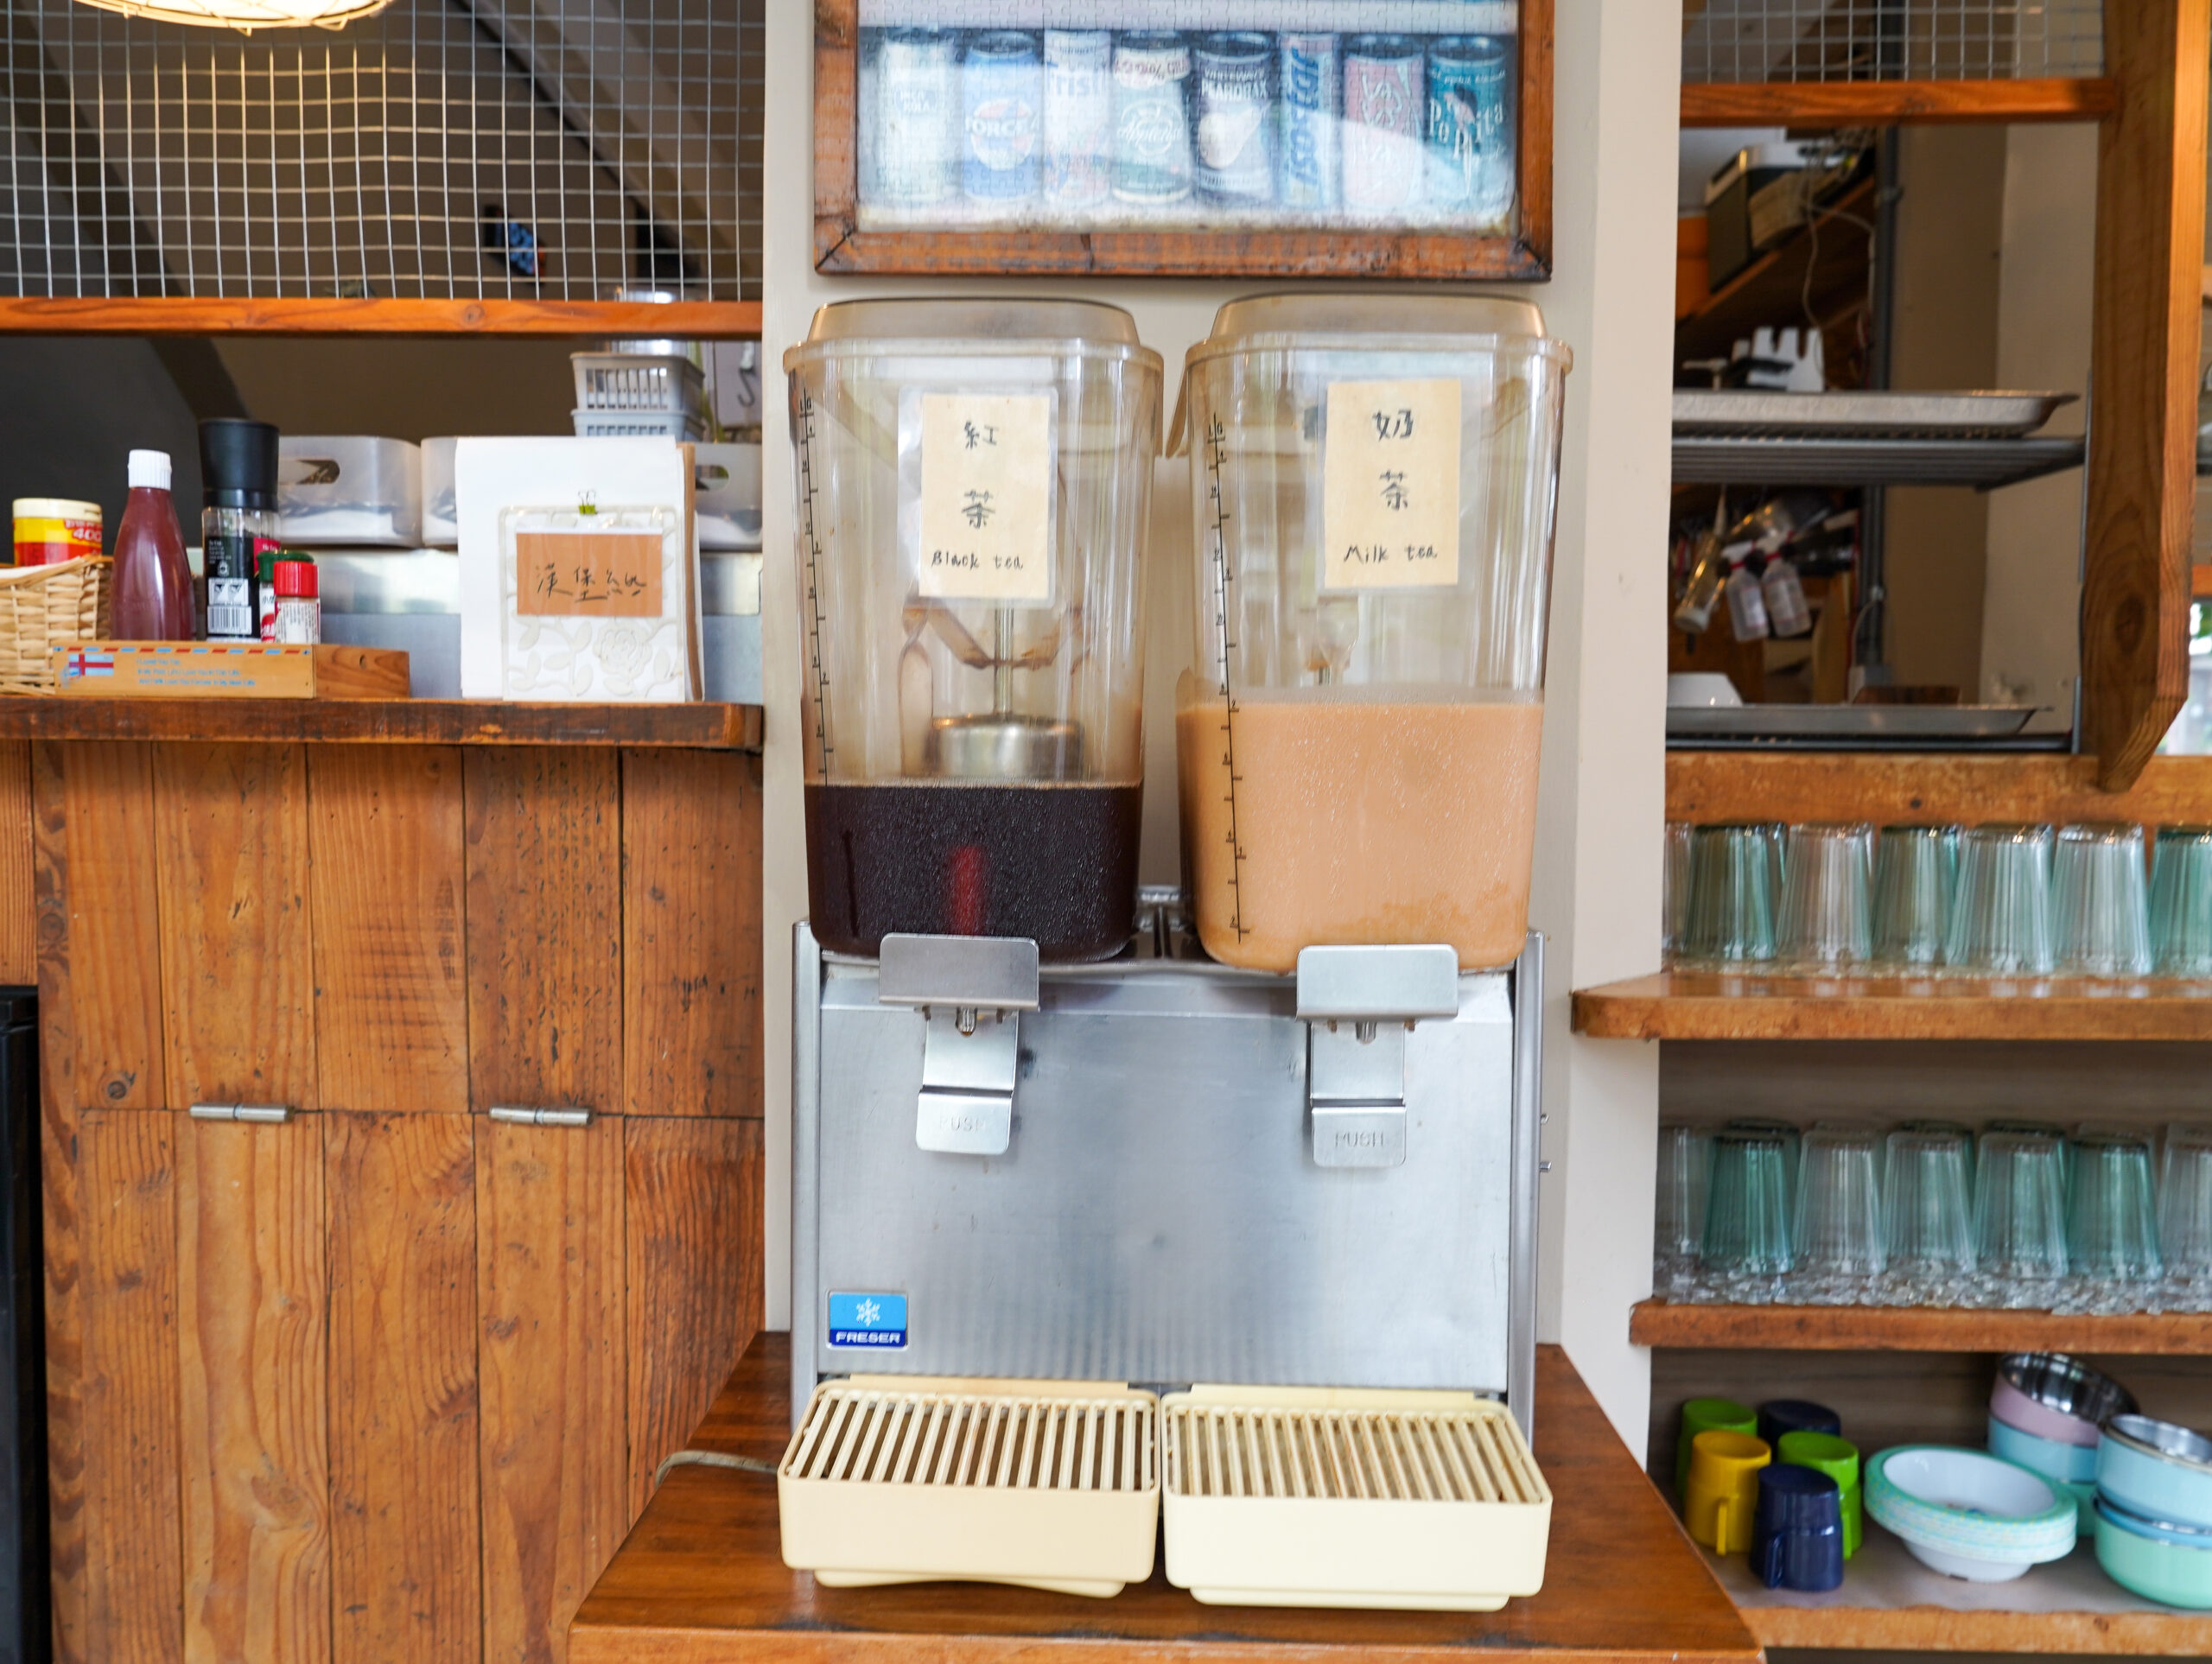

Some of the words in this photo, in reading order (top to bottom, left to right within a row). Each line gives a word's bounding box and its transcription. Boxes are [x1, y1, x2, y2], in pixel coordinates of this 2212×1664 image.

[1371, 409, 1414, 511] 奶茶
[961, 421, 999, 529] 紅茶
[931, 550, 980, 570] Black
[993, 554, 1024, 569] tea
[1344, 545, 1388, 563] Milk
[1407, 545, 1438, 562] tea
[1335, 1130, 1384, 1147] PUSH
[835, 1331, 900, 1343] FRESER
